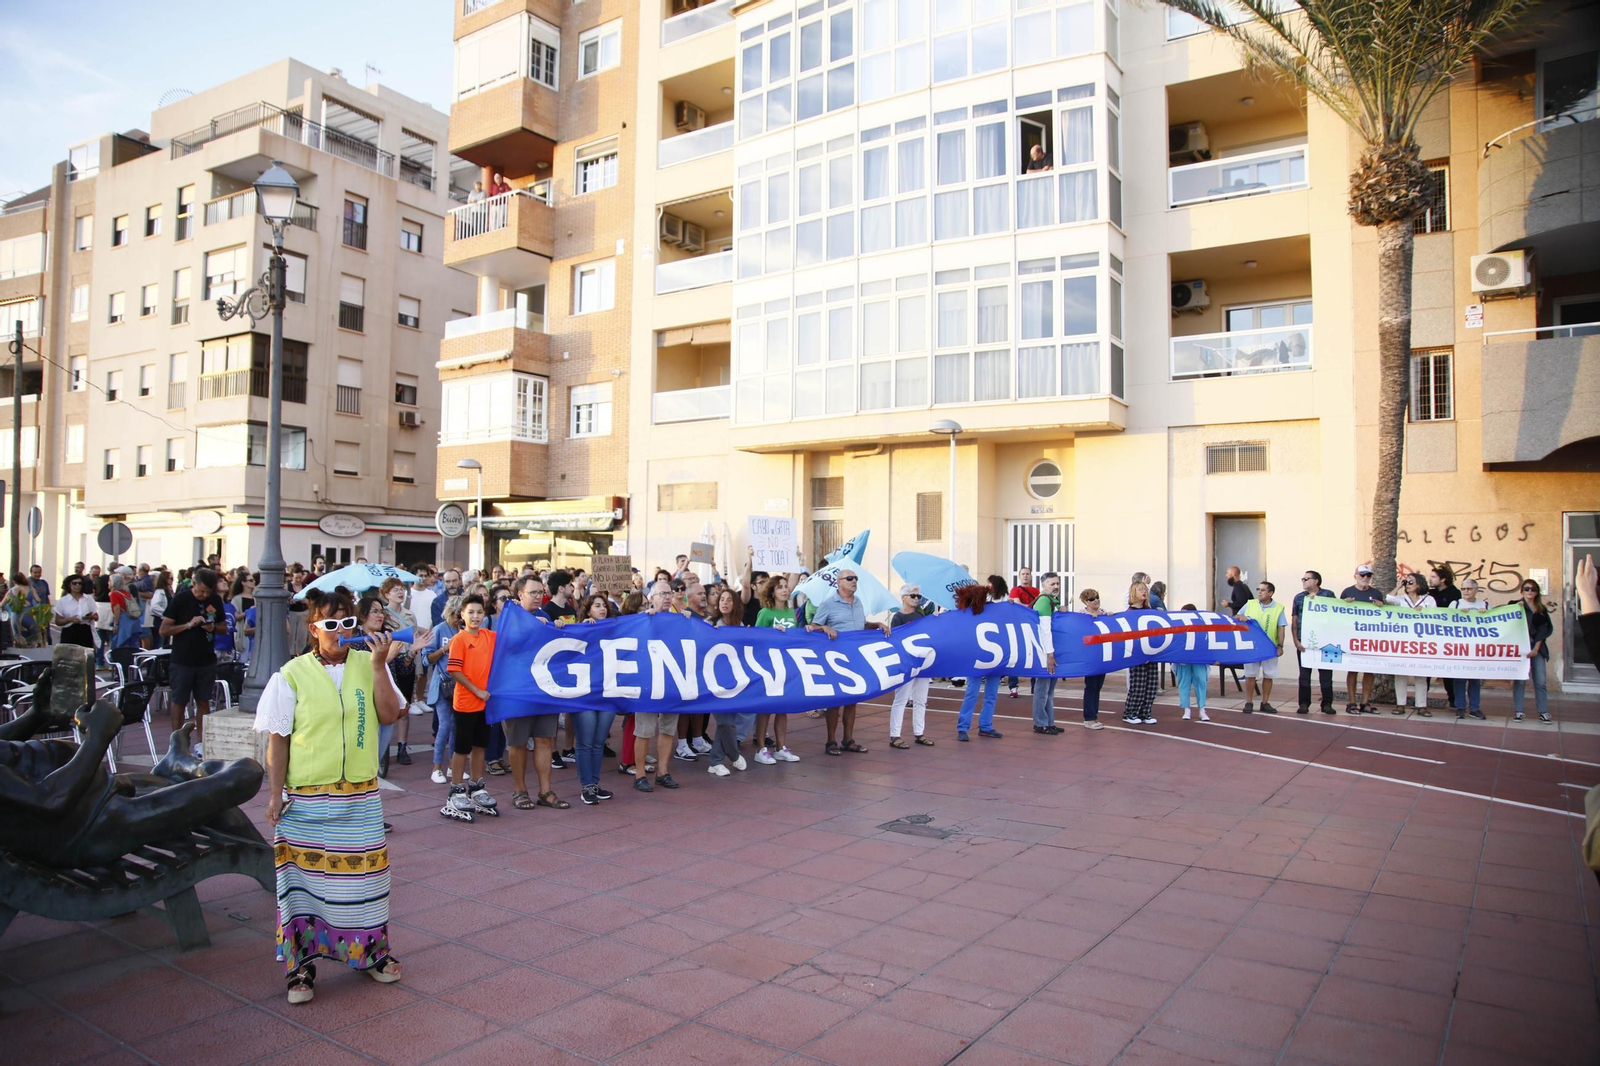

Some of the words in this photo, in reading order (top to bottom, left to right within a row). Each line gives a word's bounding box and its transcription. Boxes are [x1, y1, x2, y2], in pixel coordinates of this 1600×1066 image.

[442, 511, 463, 524] Buono
[752, 518, 769, 535] CABO
[775, 519, 790, 536] GATA
[767, 536, 778, 548] NO
[757, 549, 765, 566] SE
[594, 573, 604, 582] NO
[1308, 601, 1328, 612] Los
[1332, 605, 1381, 617] vecinos
[1386, 611, 1393, 619] y
[1397, 611, 1448, 621] vecinas
[1451, 613, 1472, 623] del
[1475, 610, 1522, 625] parque
[1354, 621, 1409, 633] también
[1413, 622, 1500, 638] QUEREMOS
[530, 633, 937, 700] GENOVESES
[974, 622, 1047, 669] SIN
[1093, 611, 1254, 663] HOTEL
[1349, 638, 1438, 655] GENOVESES
[1443, 642, 1469, 656] SIN
[1475, 643, 1521, 658] HOTEL
[1432, 662, 1445, 670] José
[355, 688, 365, 750] GREENPEACE
